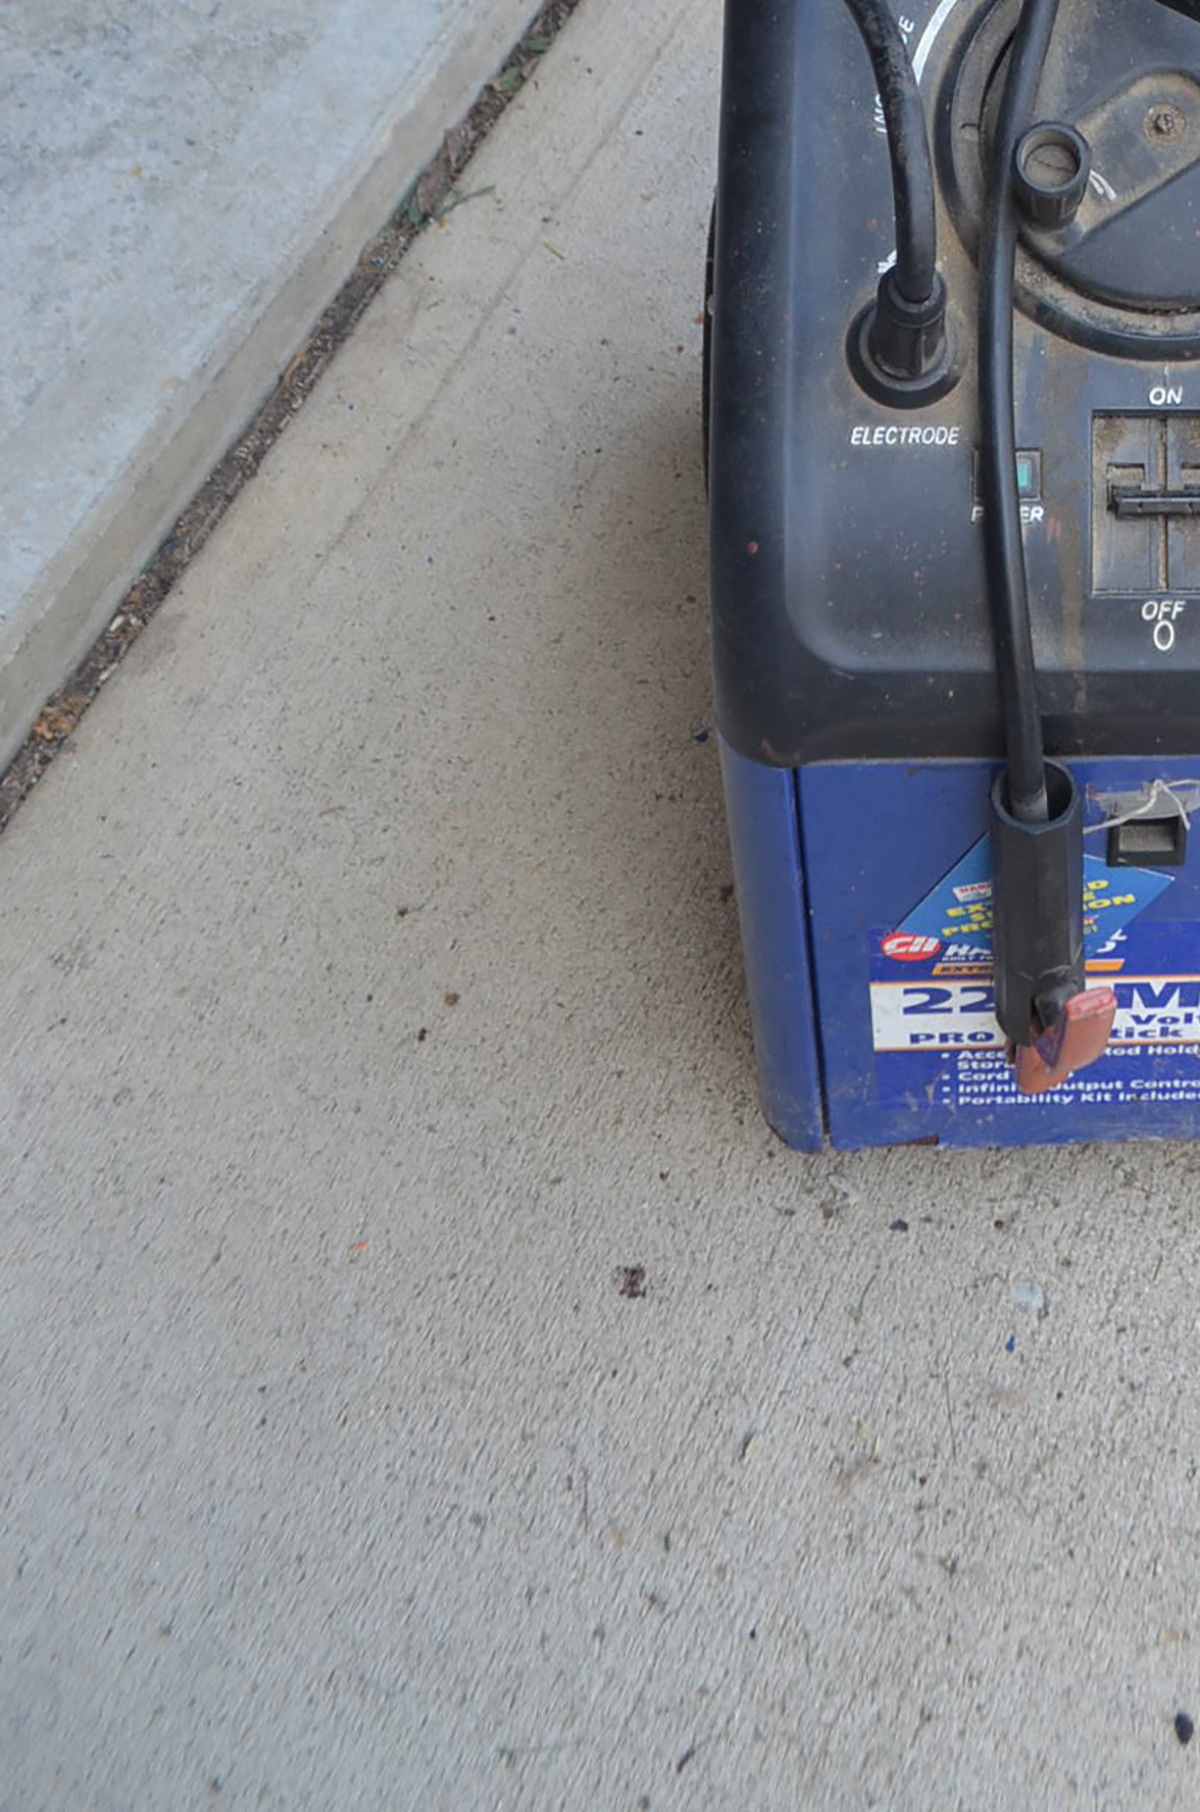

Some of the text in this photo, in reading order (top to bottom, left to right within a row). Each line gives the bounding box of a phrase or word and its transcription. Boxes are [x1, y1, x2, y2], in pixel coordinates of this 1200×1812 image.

[1149, 388, 1182, 405] ON
[850, 426, 960, 445] ELECTRODE
[971, 506, 1044, 523] PER
[1141, 601, 1185, 620] OFF
[903, 986, 995, 1016] 22
[1108, 1025, 1183, 1038] tick
[957, 1071, 1010, 1081] Cord
[958, 1094, 1075, 1105] Portability
[1080, 1093, 1113, 1103] Kit
